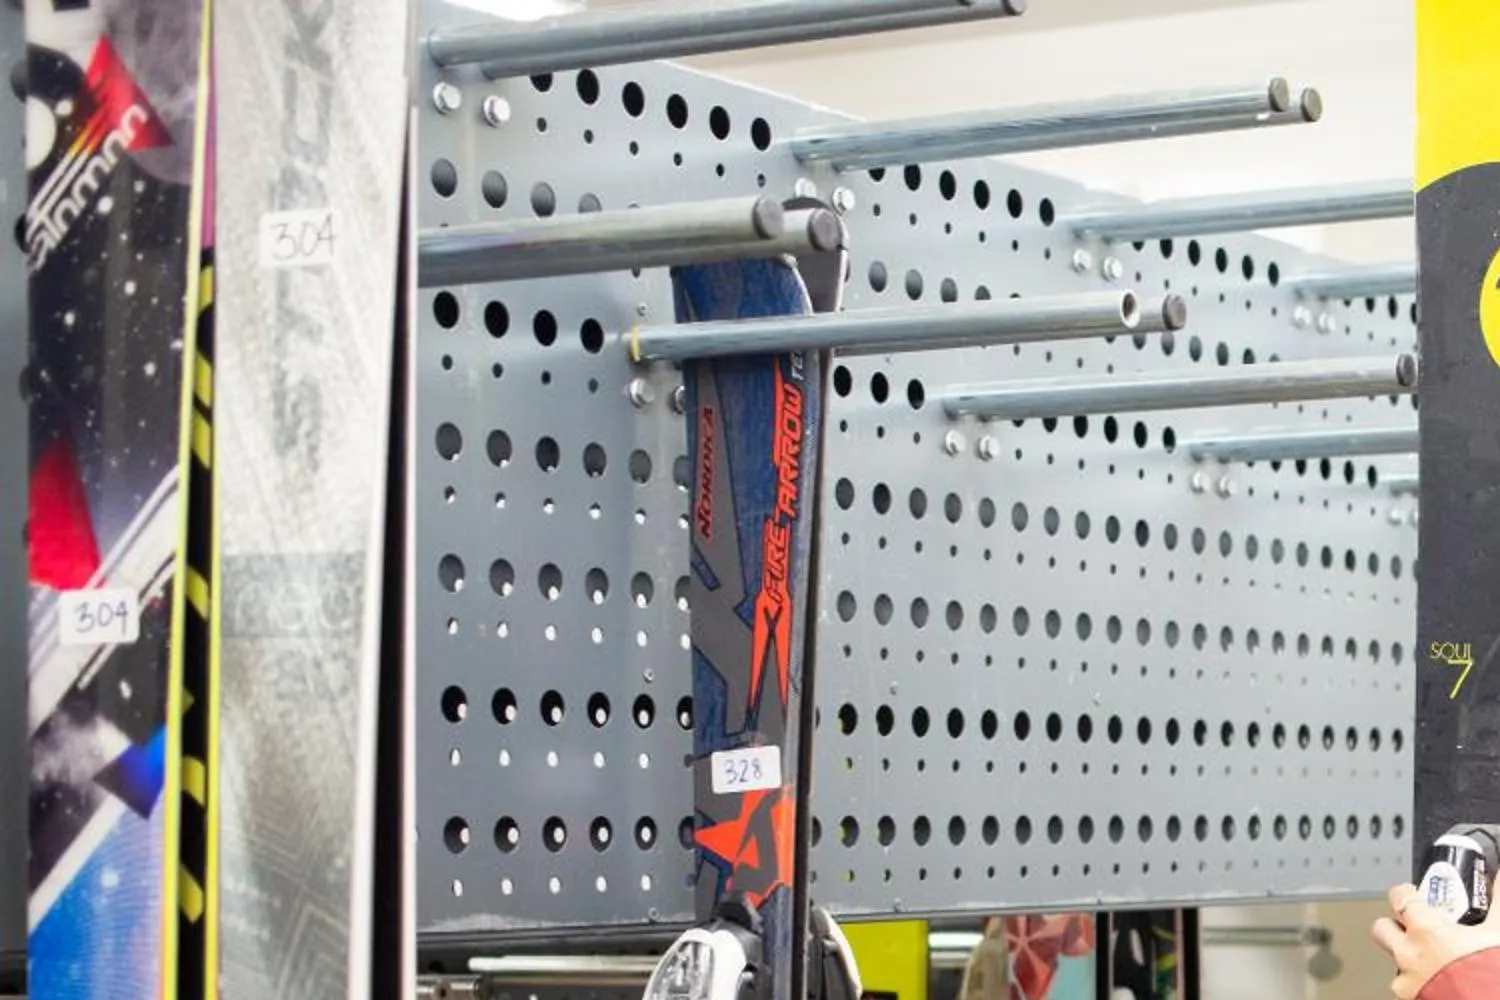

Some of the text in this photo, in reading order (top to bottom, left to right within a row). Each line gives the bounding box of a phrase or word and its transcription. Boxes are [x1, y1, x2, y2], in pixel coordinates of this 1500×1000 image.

[270, 213, 336, 261] 304
[697, 405, 714, 540] NORDICA
[763, 383, 803, 605] FIRE ARROW
[74, 600, 129, 636] 304
[1430, 641, 1472, 661] SOUL
[1447, 659, 1474, 699] 7
[724, 757, 763, 785] 328
